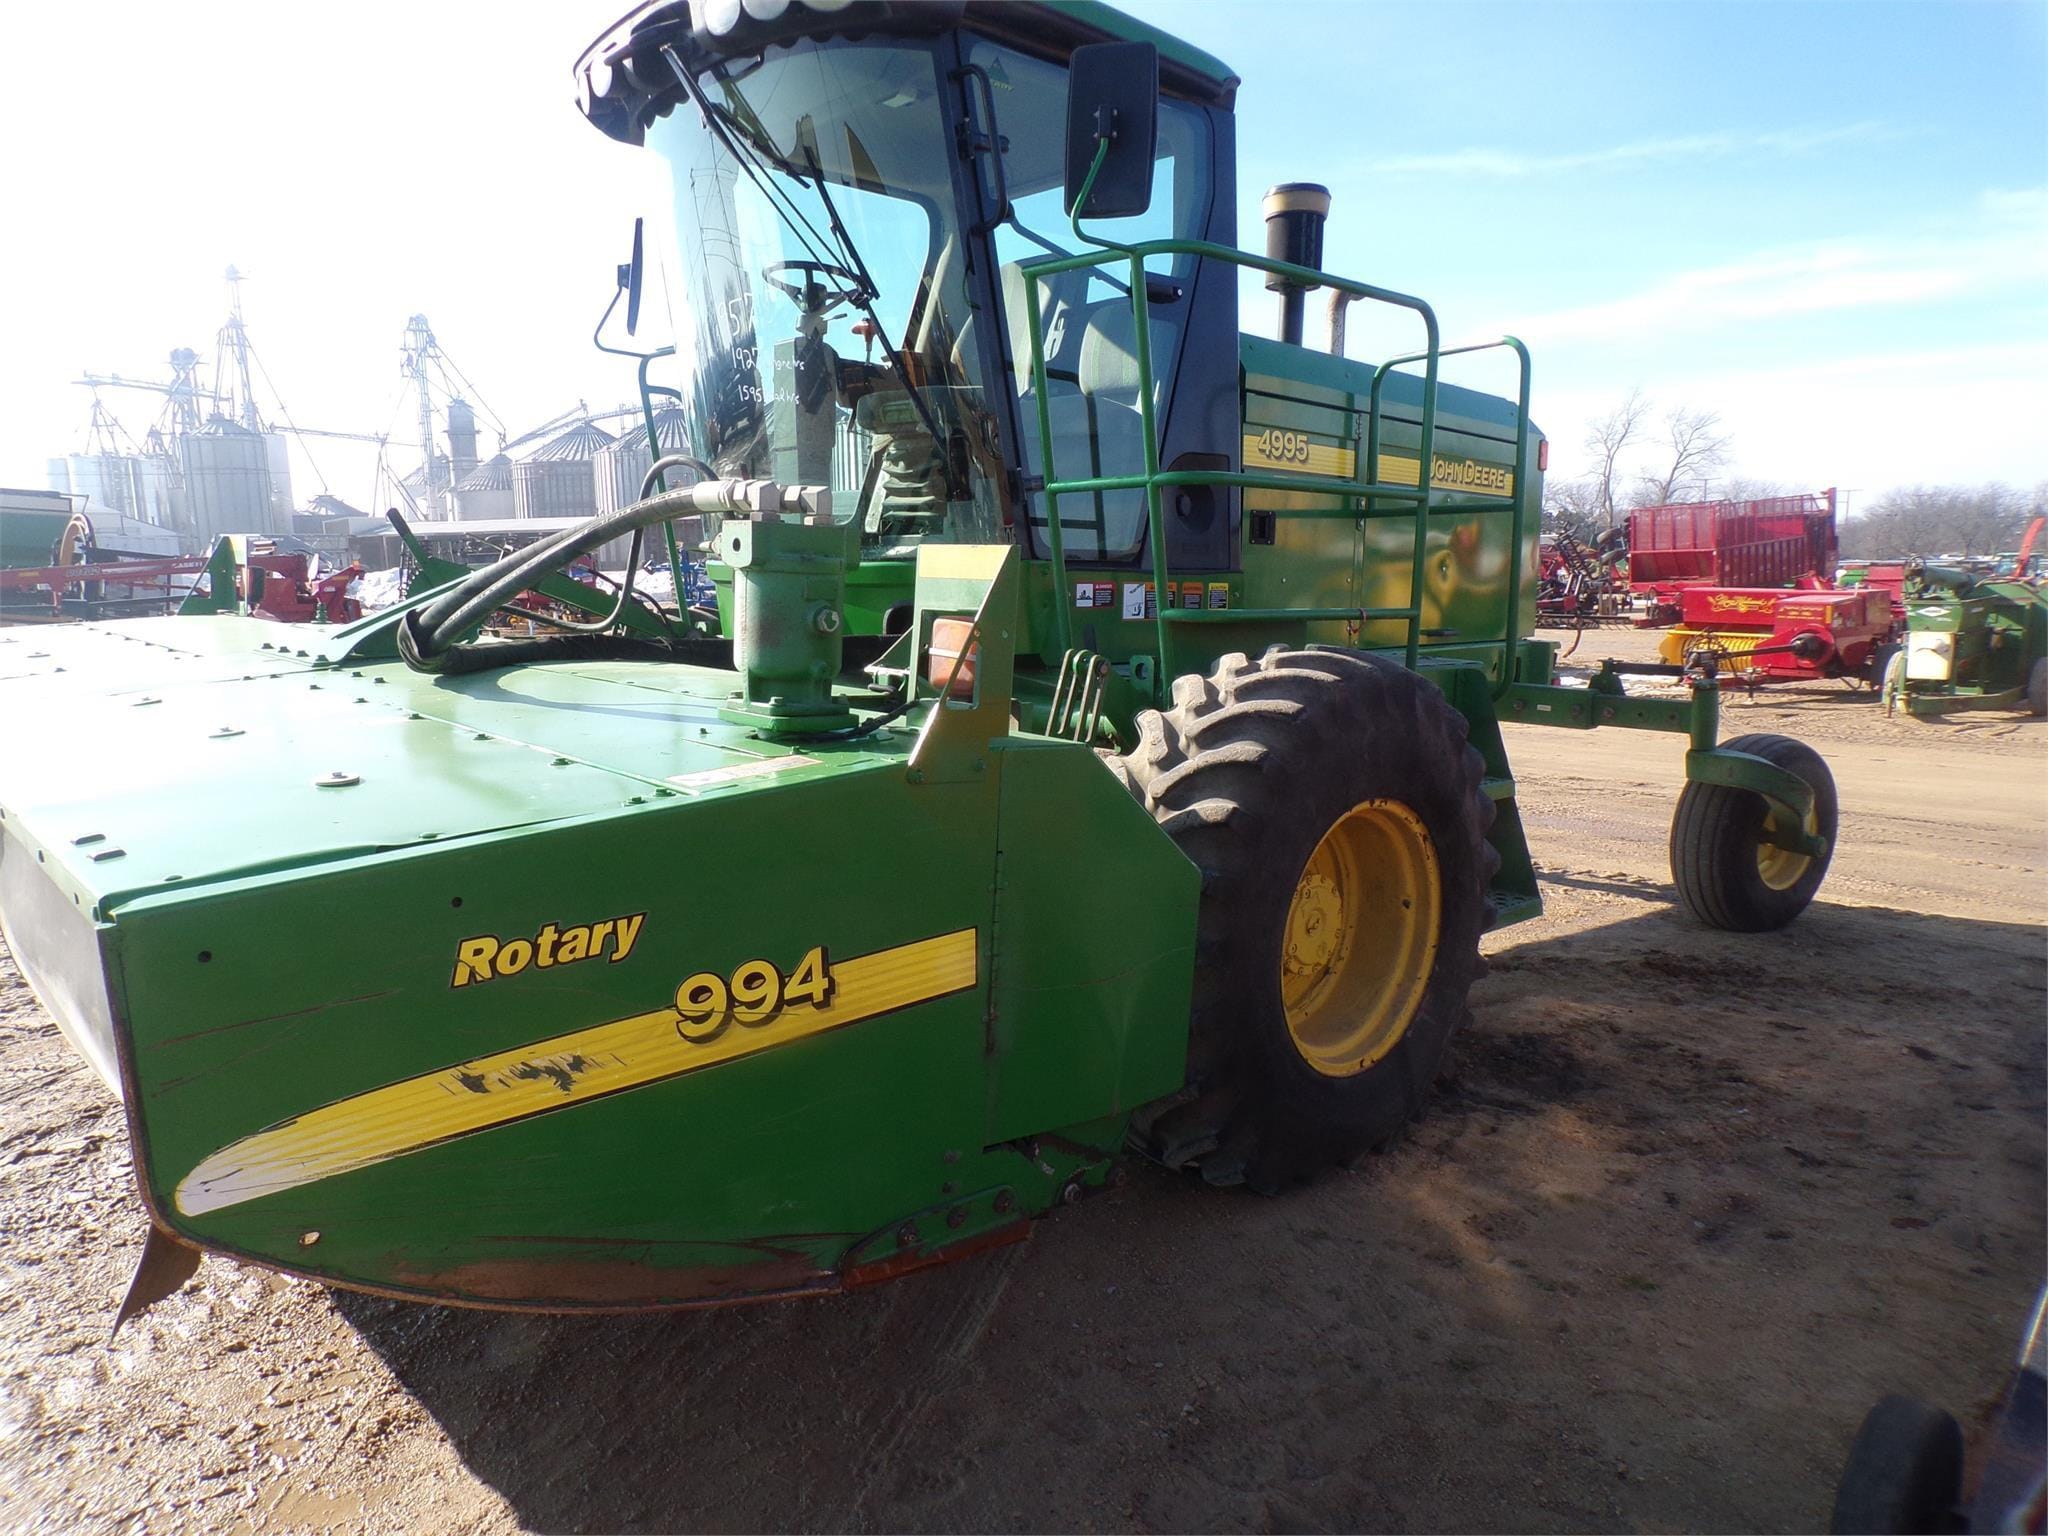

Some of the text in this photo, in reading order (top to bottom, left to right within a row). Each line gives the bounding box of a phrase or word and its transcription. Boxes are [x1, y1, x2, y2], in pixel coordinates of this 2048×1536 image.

[738, 384, 762, 403] 1595
[1258, 429, 1309, 464] 4995
[450, 911, 648, 988] Rotary
[674, 946, 836, 1044] 994
